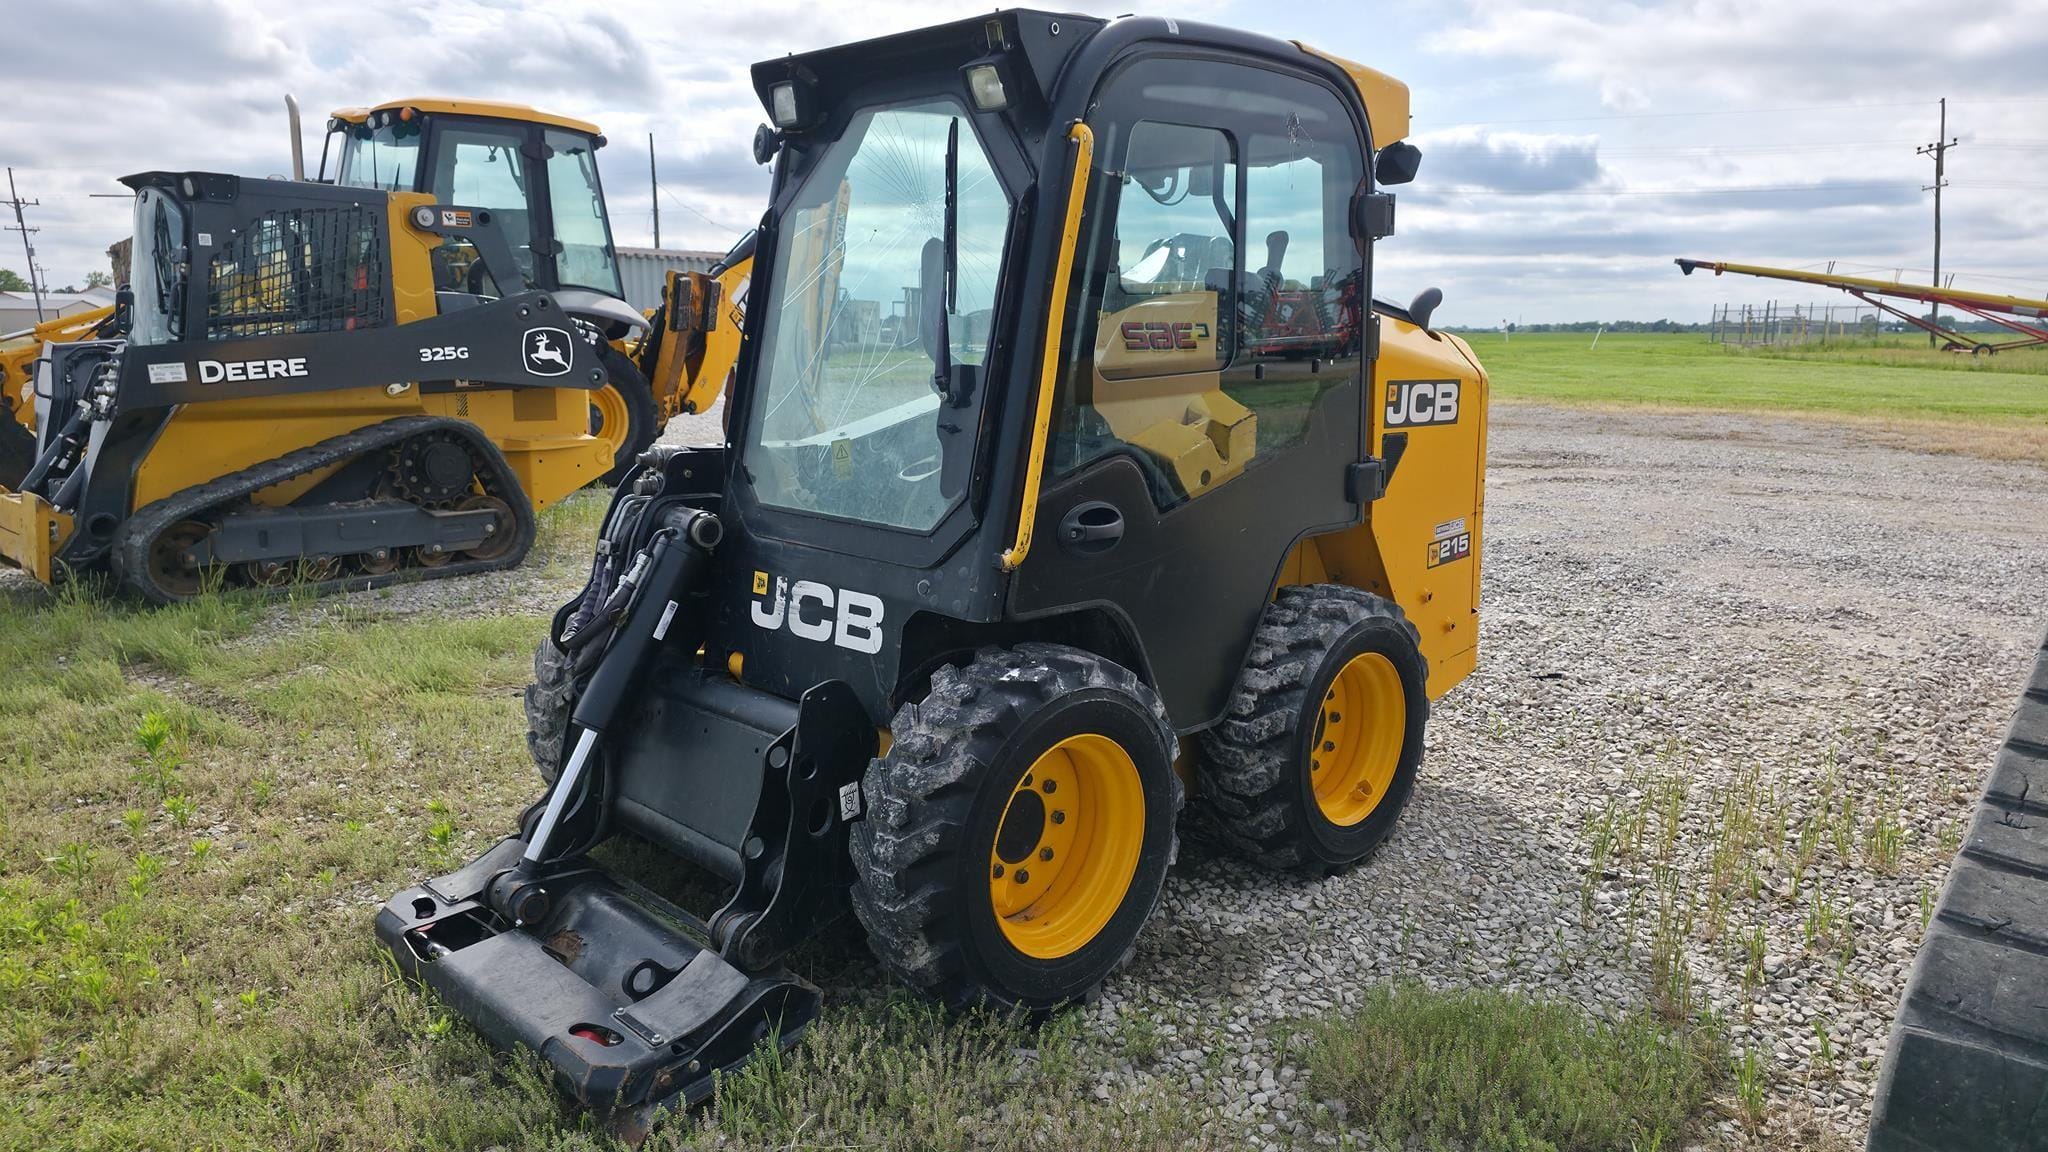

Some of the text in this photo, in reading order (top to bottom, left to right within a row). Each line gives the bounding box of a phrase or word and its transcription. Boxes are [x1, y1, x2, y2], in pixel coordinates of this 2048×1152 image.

[419, 347, 469, 362] 325G
[198, 358, 308, 383] DEERE
[1386, 383, 1459, 425] JCB
[1440, 533, 1469, 559] 215
[751, 575, 884, 655] JCB
